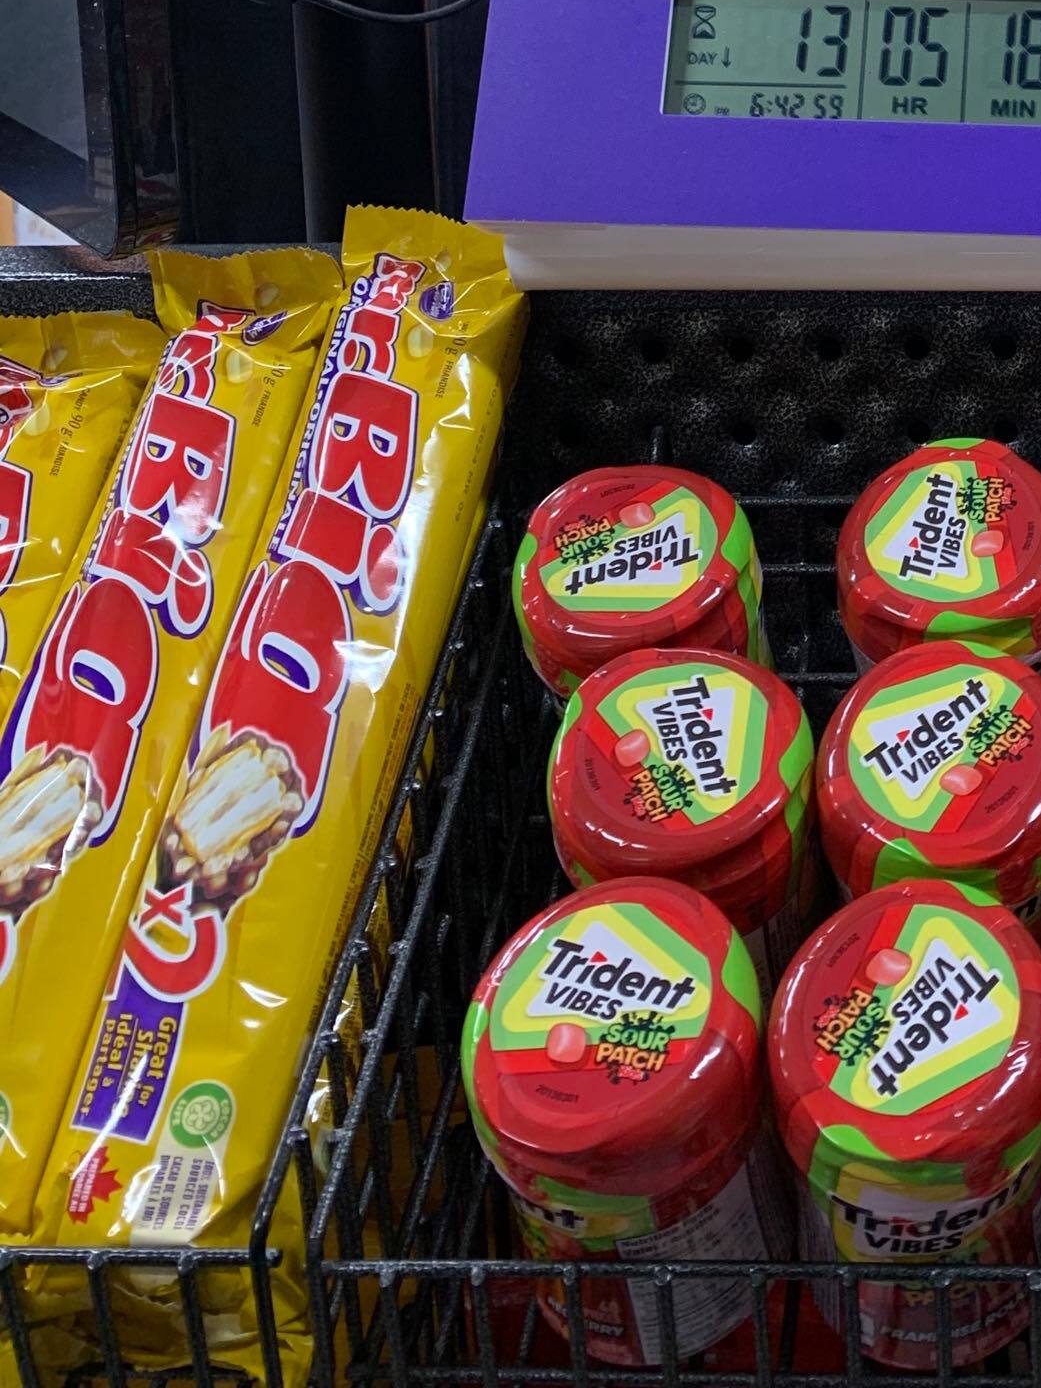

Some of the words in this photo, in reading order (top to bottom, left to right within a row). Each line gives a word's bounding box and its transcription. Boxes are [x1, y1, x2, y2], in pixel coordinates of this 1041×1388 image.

[688, 52, 717, 66] DAY
[795, 5, 850, 78] 13
[878, 6, 950, 88] 05
[891, 96, 928, 115] HR
[991, 99, 1036, 118] MIN
[435, 361, 454, 398] FRIANDISE
[69, 413, 84, 431] 90
[252, 390, 270, 428] FRIANDISE
[267, 402, 325, 554] ORIGINALE
[970, 479, 988, 522] SOUR
[984, 478, 1004, 522] PATCH
[614, 525, 677, 556] VIBES
[899, 474, 953, 577] Trident
[938, 517, 966, 568] VIBES
[565, 538, 698, 595] Trident
[652, 702, 687, 761] VIBES
[672, 677, 737, 794] Trident
[864, 678, 986, 776] Trident
[970, 711, 1018, 754] SOUR
[980, 719, 1032, 766] PATCH
[901, 732, 963, 784] VIBES
[632, 770, 668, 822] PATCH
[652, 764, 684, 812] SOUR
[544, 939, 696, 1009] Trident
[892, 957, 955, 1025] VIBES
[545, 982, 623, 1020] VIBES
[816, 988, 873, 1051] PATCH
[108, 1013, 133, 1071] Idéal
[147, 1016, 177, 1080] Great
[606, 1024, 671, 1052] SOUR
[833, 1003, 885, 1058] SOUR
[871, 962, 999, 1096] Trident
[81, 1019, 116, 1116] partager
[102, 1076, 115, 1088] à
[596, 1043, 667, 1072] PATCH
[138, 1084, 156, 1107] for
[864, 1231, 964, 1254] VIBES
